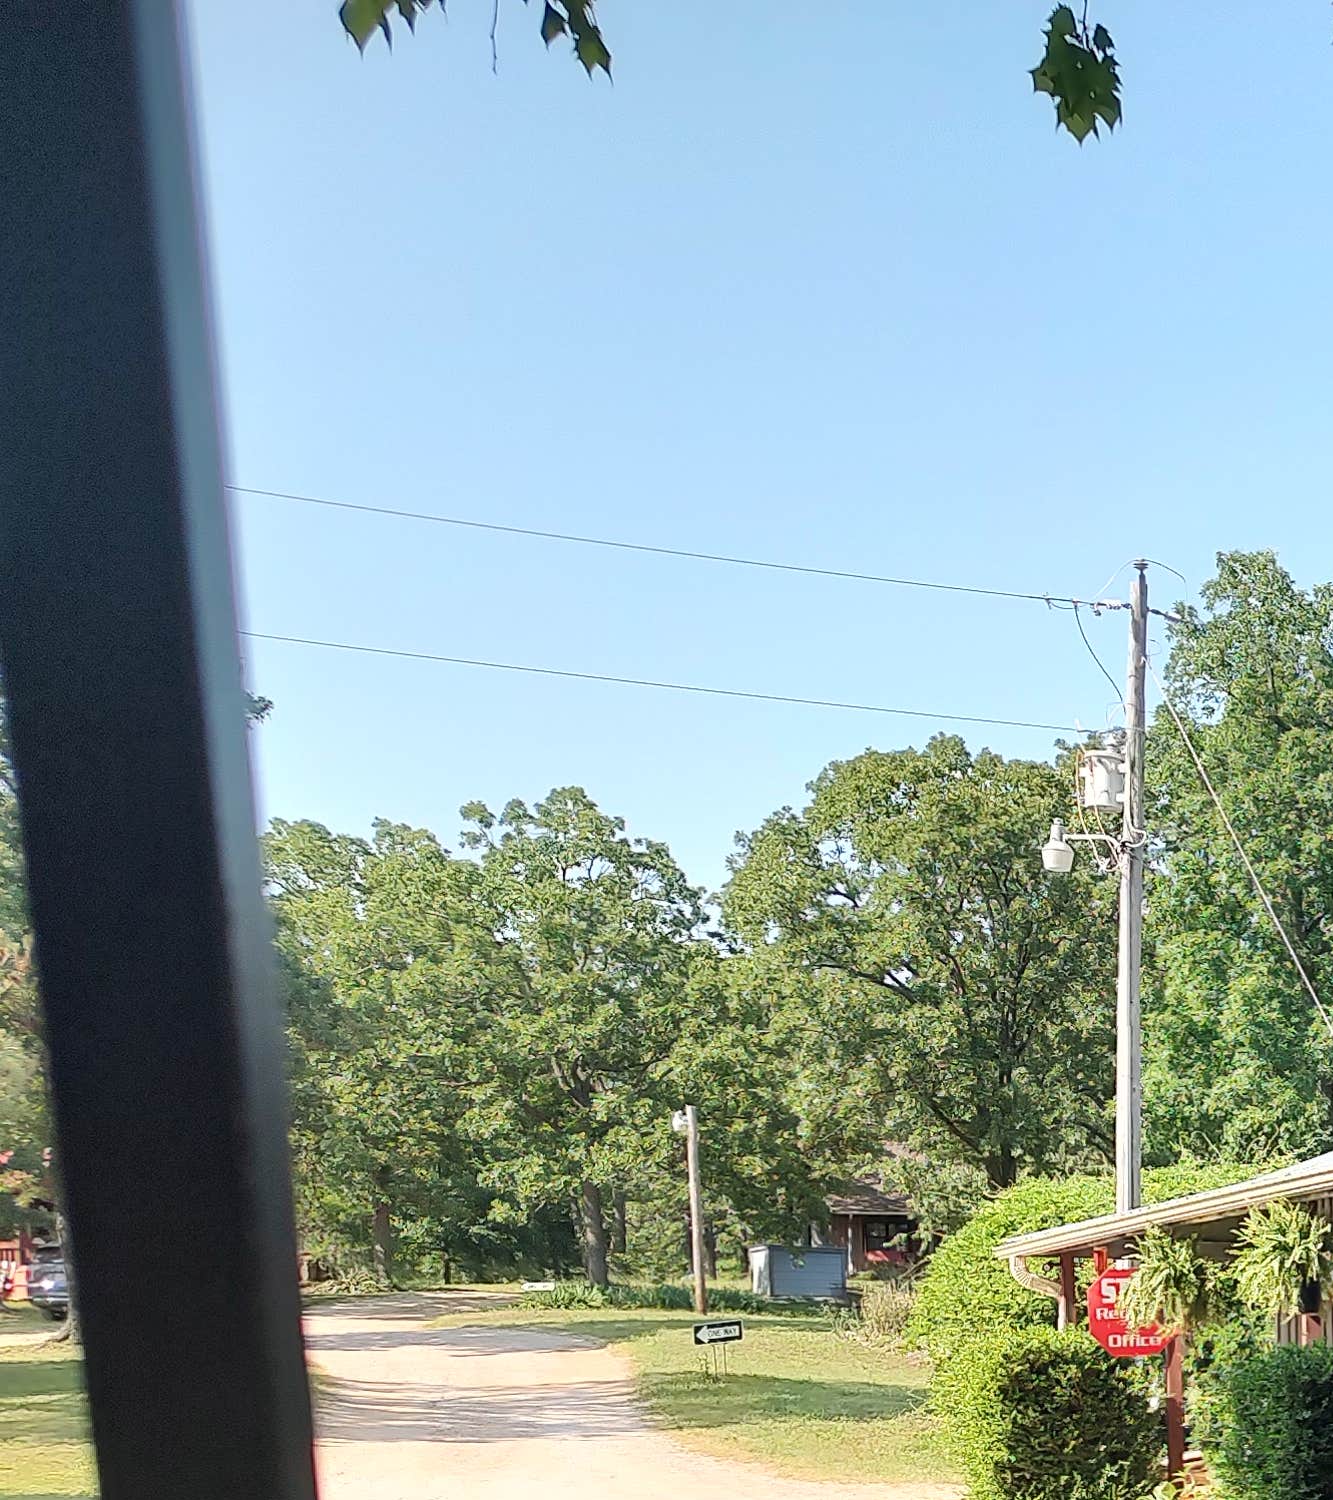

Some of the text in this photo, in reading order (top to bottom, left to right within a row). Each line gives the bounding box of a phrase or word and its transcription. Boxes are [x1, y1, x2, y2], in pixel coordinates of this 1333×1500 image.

[708, 1327, 737, 1338] ONE WAY
[1108, 1334, 1162, 1347] Office
